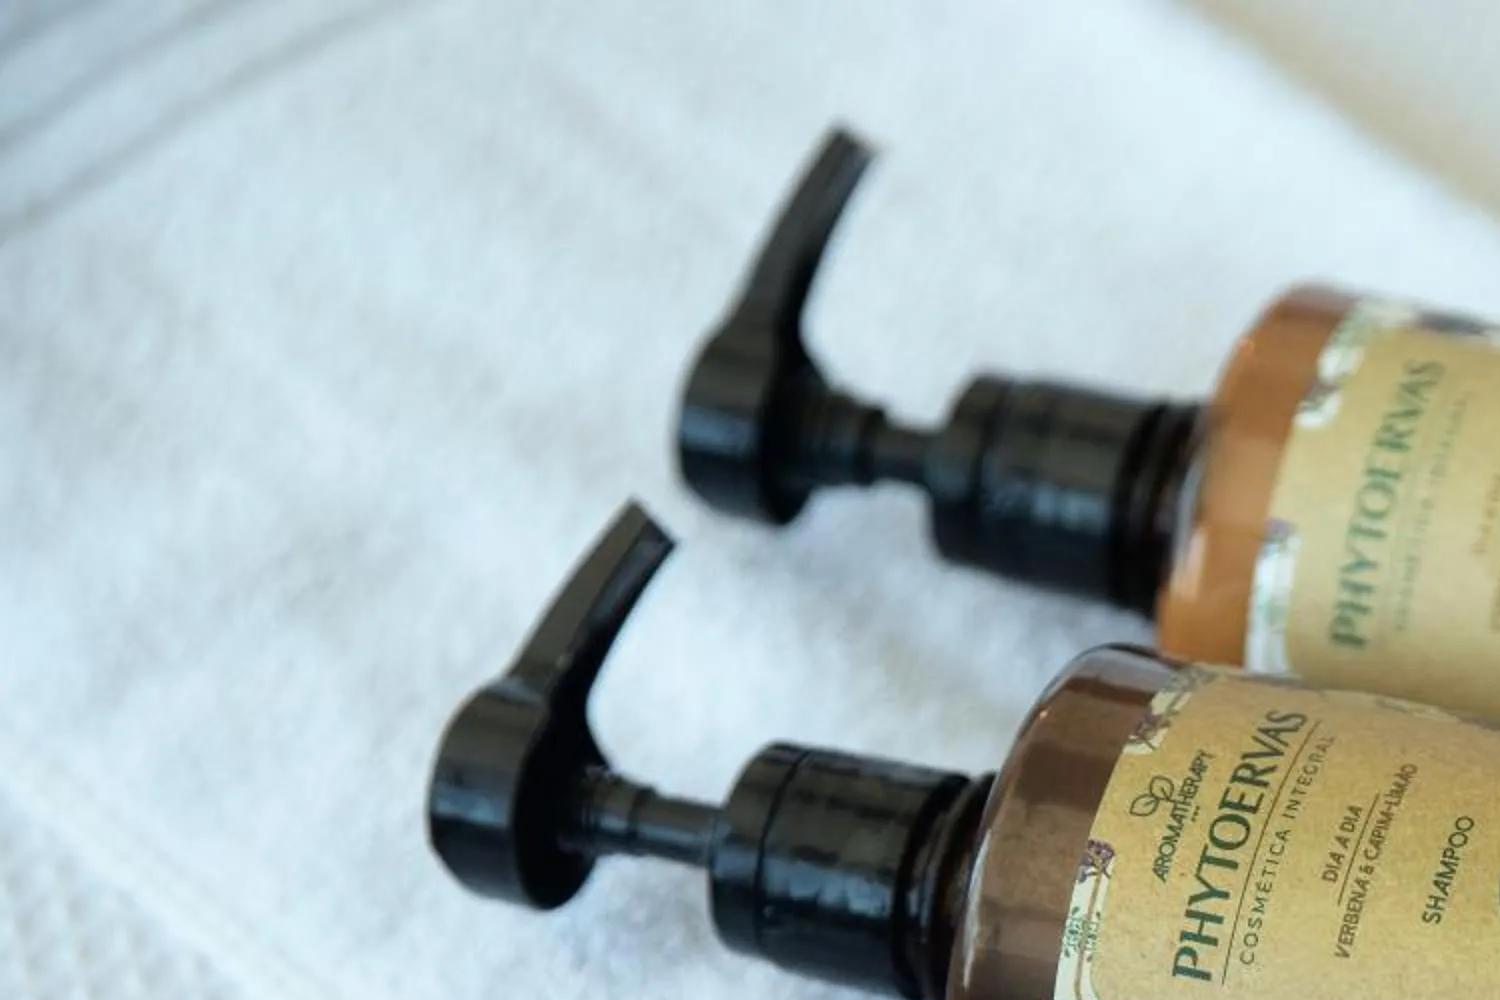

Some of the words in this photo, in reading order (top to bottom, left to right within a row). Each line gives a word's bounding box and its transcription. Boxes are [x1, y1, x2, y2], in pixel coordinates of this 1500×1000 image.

[1329, 360, 1446, 650] PHYTOERVAS
[1152, 749, 1215, 883] AROMATHERAPY
[1172, 709, 1308, 982] PHYTOERVAS
[1240, 828, 1292, 965] COSMÉTICA
[1283, 736, 1336, 820] INTEGRAL
[1321, 852, 1346, 883] DIA
[1334, 835, 1350, 850] A
[1339, 805, 1363, 833] DIA
[1421, 815, 1475, 924] SHAMPOO
[1335, 877, 1371, 959] VERBENA
